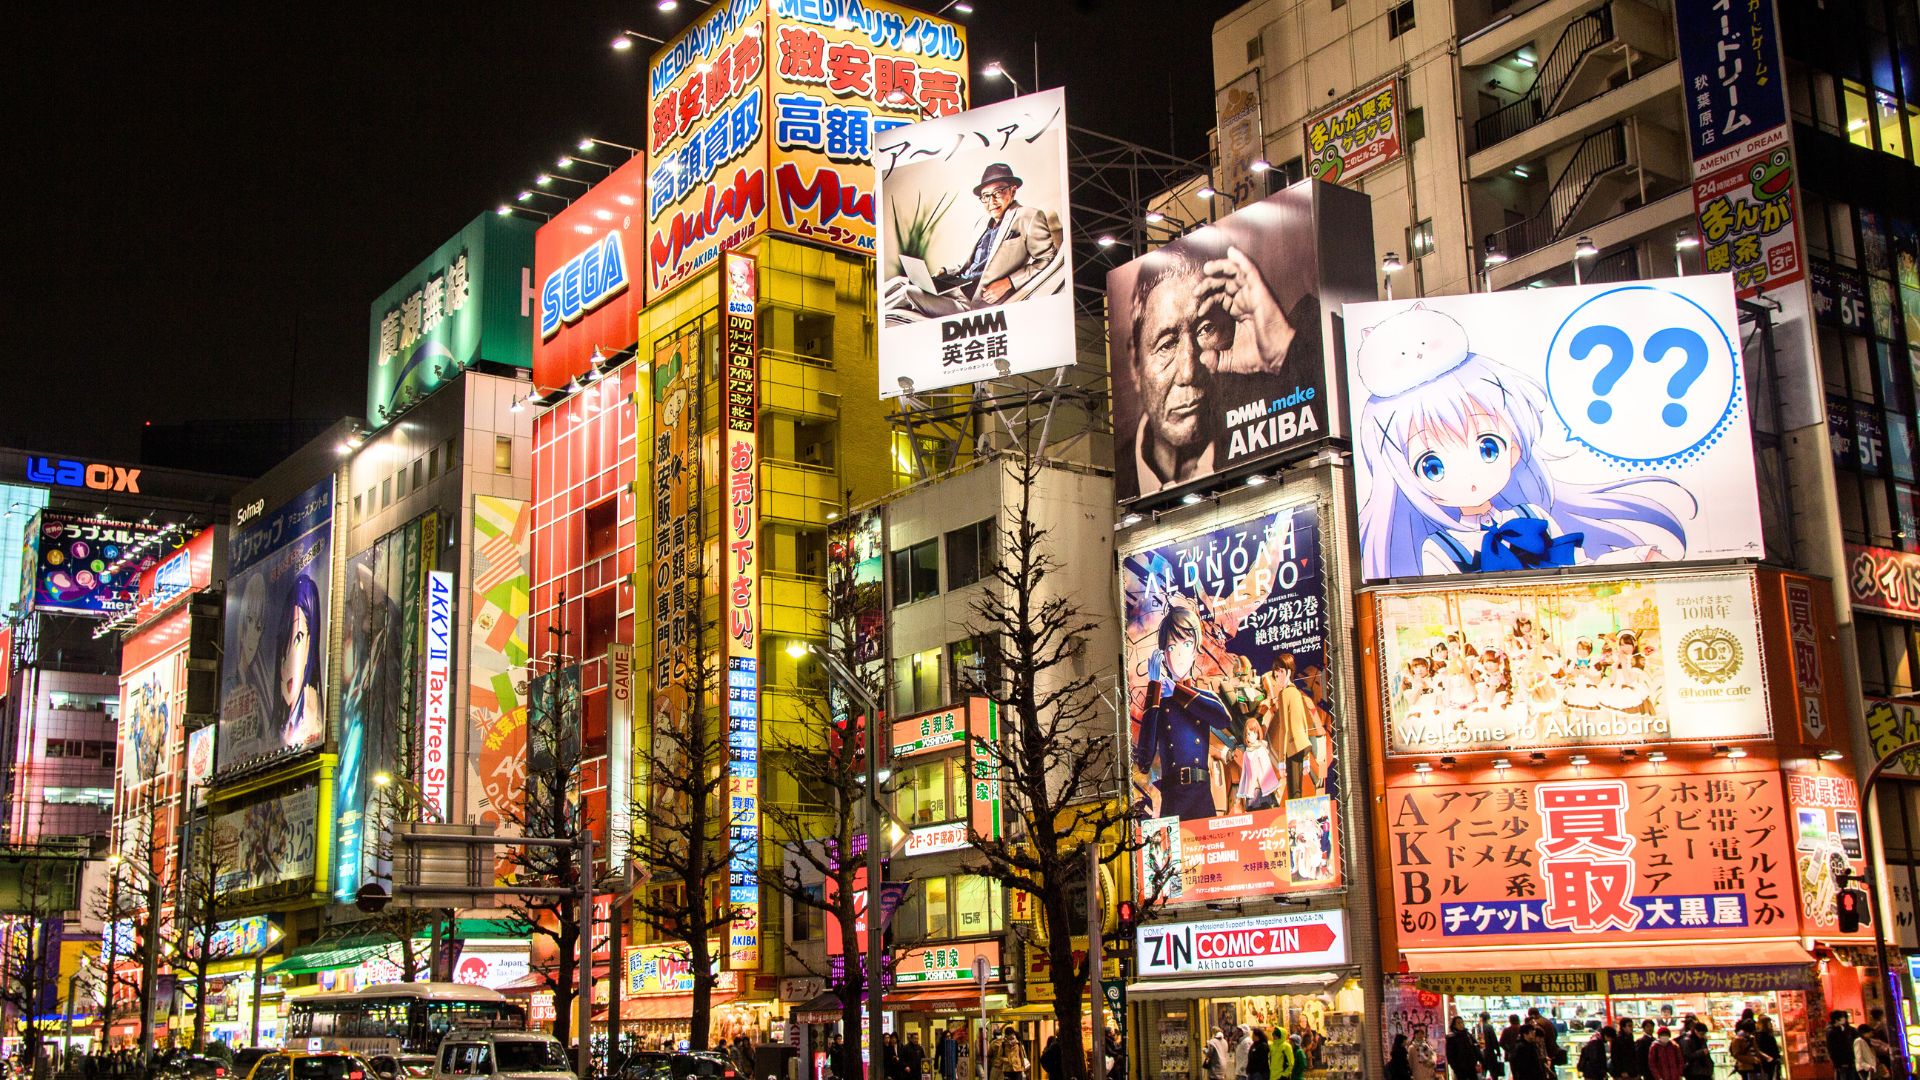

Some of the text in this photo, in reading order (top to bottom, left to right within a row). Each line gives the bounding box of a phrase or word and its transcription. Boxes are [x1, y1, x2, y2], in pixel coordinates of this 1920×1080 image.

[778, 0, 961, 59] MEDIAリサイクル
[780, 27, 960, 117] 激安販売
[653, 25, 761, 151] 激安販売
[1310, 91, 1393, 153] まんが喫茶
[1694, 75, 1715, 146] 秋葉原店
[779, 96, 913, 156] 高額
[1343, 115, 1392, 152] ゲラゲラ
[652, 90, 761, 215] 高額買取
[1345, 141, 1386, 168] このビル3F
[1699, 130, 1783, 172] AMENITY DREAM
[651, 168, 765, 290] Mulan
[1701, 196, 1790, 240] まんが
[797, 219, 876, 251] ムーラン AK
[1707, 234, 1760, 272] 喫茶
[1772, 255, 1793, 272] 3F
[542, 230, 629, 339] SEGA
[730, 317, 752, 331] DVD
[942, 310, 1007, 342] DMM
[1841, 296, 1865, 327] 6F
[730, 342, 753, 356] ゲーム
[733, 355, 749, 367] CD
[942, 334, 1008, 367] 英会話
[729, 367, 753, 380] アイドル
[729, 381, 753, 393] アニメ
[730, 393, 752, 406] コミック
[731, 406, 752, 418] ホビー
[1226, 386, 1315, 429] DMM.make
[730, 418, 752, 431] フィギュア
[1228, 404, 1319, 460] AKIBA
[1858, 435, 1882, 466] 5F
[76, 517, 133, 529] AMUSEMENT
[237, 498, 264, 526] Sofmap
[656, 433, 671, 691] 激安販売の専門店
[432, 576, 449, 647] AKKY
[671, 516, 687, 680] 高額買取と
[1676, 595, 1733, 606] おかげさまで
[1683, 605, 1731, 619] 10周年
[1238, 595, 1319, 631] コミック第2巻
[1255, 617, 1319, 646] 絶賛発売中!
[1787, 583, 1822, 693] 買取
[729, 659, 756, 672] 6F 中古
[1694, 646, 1718, 661] 10
[615, 651, 629, 700] GAME
[741, 689, 756, 701] 中古
[1679, 684, 1751, 698] @home cafe
[429, 666, 447, 763] Tax-free
[730, 719, 757, 731] 4F 中古
[732, 707, 755, 716] DVD
[921, 713, 954, 736] 吉野家
[1808, 701, 1819, 729] 入口
[1399, 715, 1668, 746] Welcome to Akihabara
[741, 751, 757, 761] 中古
[732, 797, 755, 809] 買取
[931, 799, 944, 811] 3階
[730, 827, 740, 837] 1F
[1240, 827, 1286, 841] アンソロジー
[1464, 789, 1495, 868] アニメ
[1671, 782, 1702, 860] ホビー
[1704, 779, 1745, 891] 携帯電話
[284, 817, 314, 865] 3.25
[1259, 839, 1286, 851] コミック
[1433, 791, 1469, 896] アイドル
[1496, 787, 1536, 897] 美少女系
[1637, 783, 1673, 893] フィギュア
[1740, 778, 1784, 925] アップルとか
[1543, 785, 1631, 927] 買取
[730, 873, 743, 884] B1F
[731, 889, 757, 900] PCゲーム
[961, 912, 981, 925] 15席
[1195, 921, 1225, 930] Professional
[1226, 918, 1247, 929] Support
[1256, 915, 1283, 926] Magazine
[1290, 914, 1324, 923] MANGA-ZIN
[1444, 896, 1743, 933] チケット 大黒屋
[732, 936, 757, 946] AKIBA
[1143, 928, 1164, 937] COMIC
[1197, 928, 1300, 957] COMIC ZIN
[925, 948, 958, 969] 吉野家
[1143, 926, 1192, 971] ZIN
[1197, 959, 1254, 970] Akihabara
[1521, 973, 1585, 983] WESTERN
[787, 981, 820, 999] ラーメン
[1421, 976, 1512, 985] MONEY TRANSFER
[1541, 983, 1585, 992] UNION
